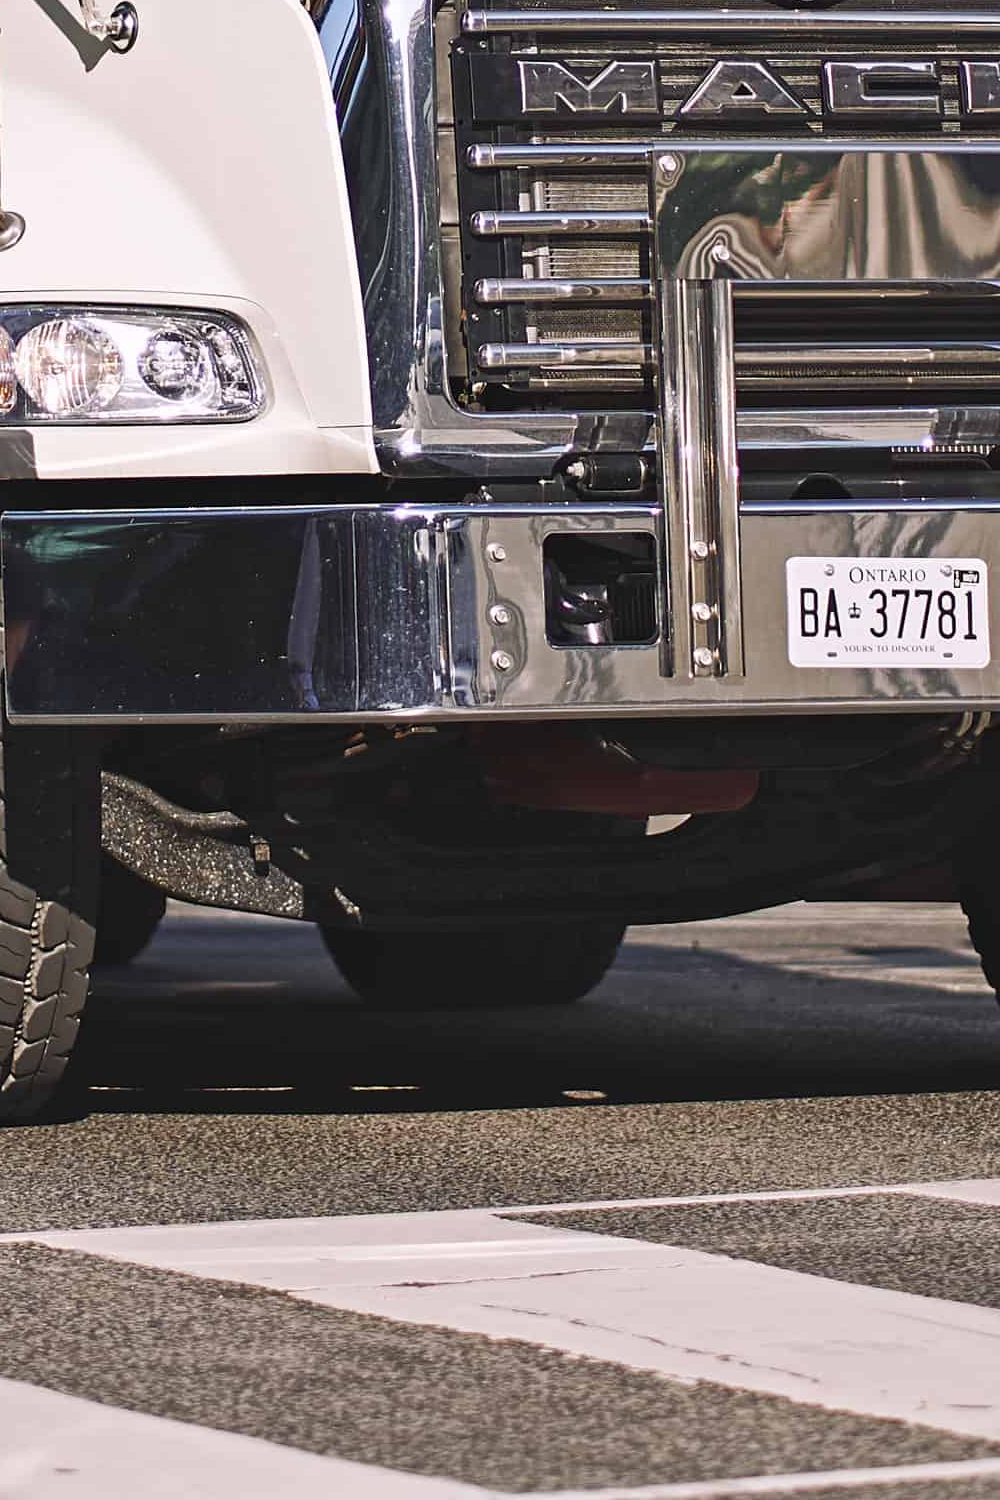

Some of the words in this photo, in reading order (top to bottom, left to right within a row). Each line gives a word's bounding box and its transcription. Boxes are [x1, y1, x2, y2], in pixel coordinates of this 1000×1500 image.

[517, 59, 1000, 114] MAC
[849, 566, 926, 584] ONTARIO
[800, 587, 842, 638] BA
[868, 588, 977, 640] 37781
[843, 644, 873, 653] YOURS
[877, 644, 889, 653] TO
[891, 644, 936, 653] DISCOVER
